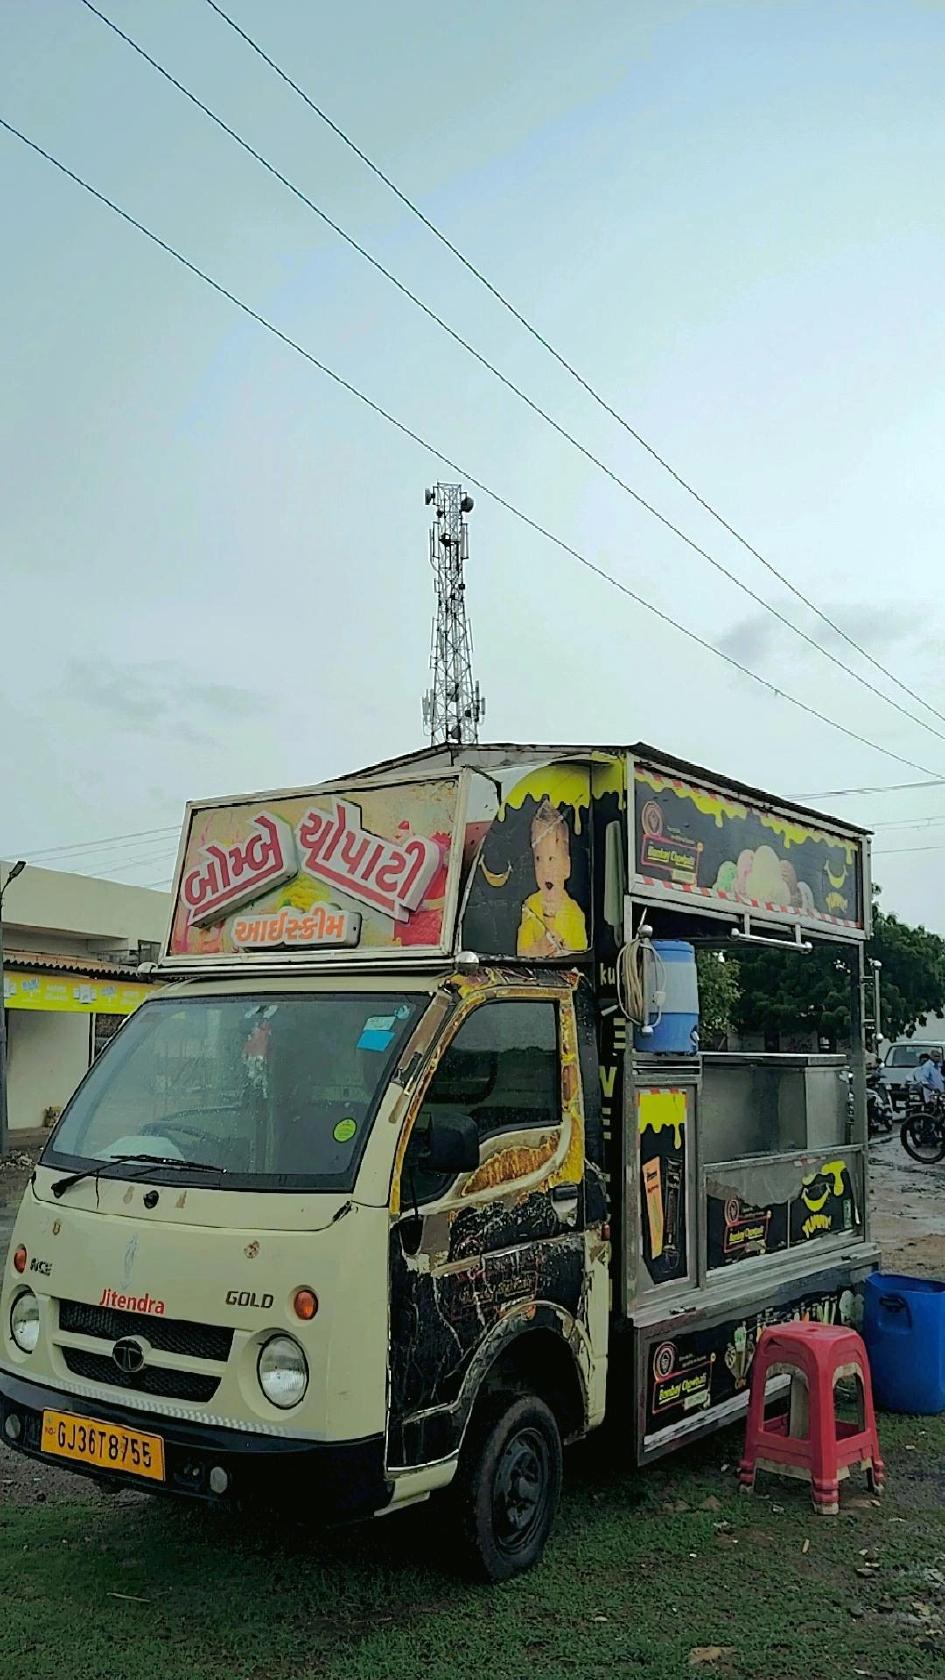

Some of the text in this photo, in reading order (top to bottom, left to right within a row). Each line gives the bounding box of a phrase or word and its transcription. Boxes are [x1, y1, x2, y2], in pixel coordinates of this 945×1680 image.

[184, 803, 427, 916] બોમ્બે ચોપાટી
[99, 1288, 165, 1314] Jitendra
[225, 1290, 274, 1309] GOLD
[57, 1421, 151, 1468] GJ36T8755
